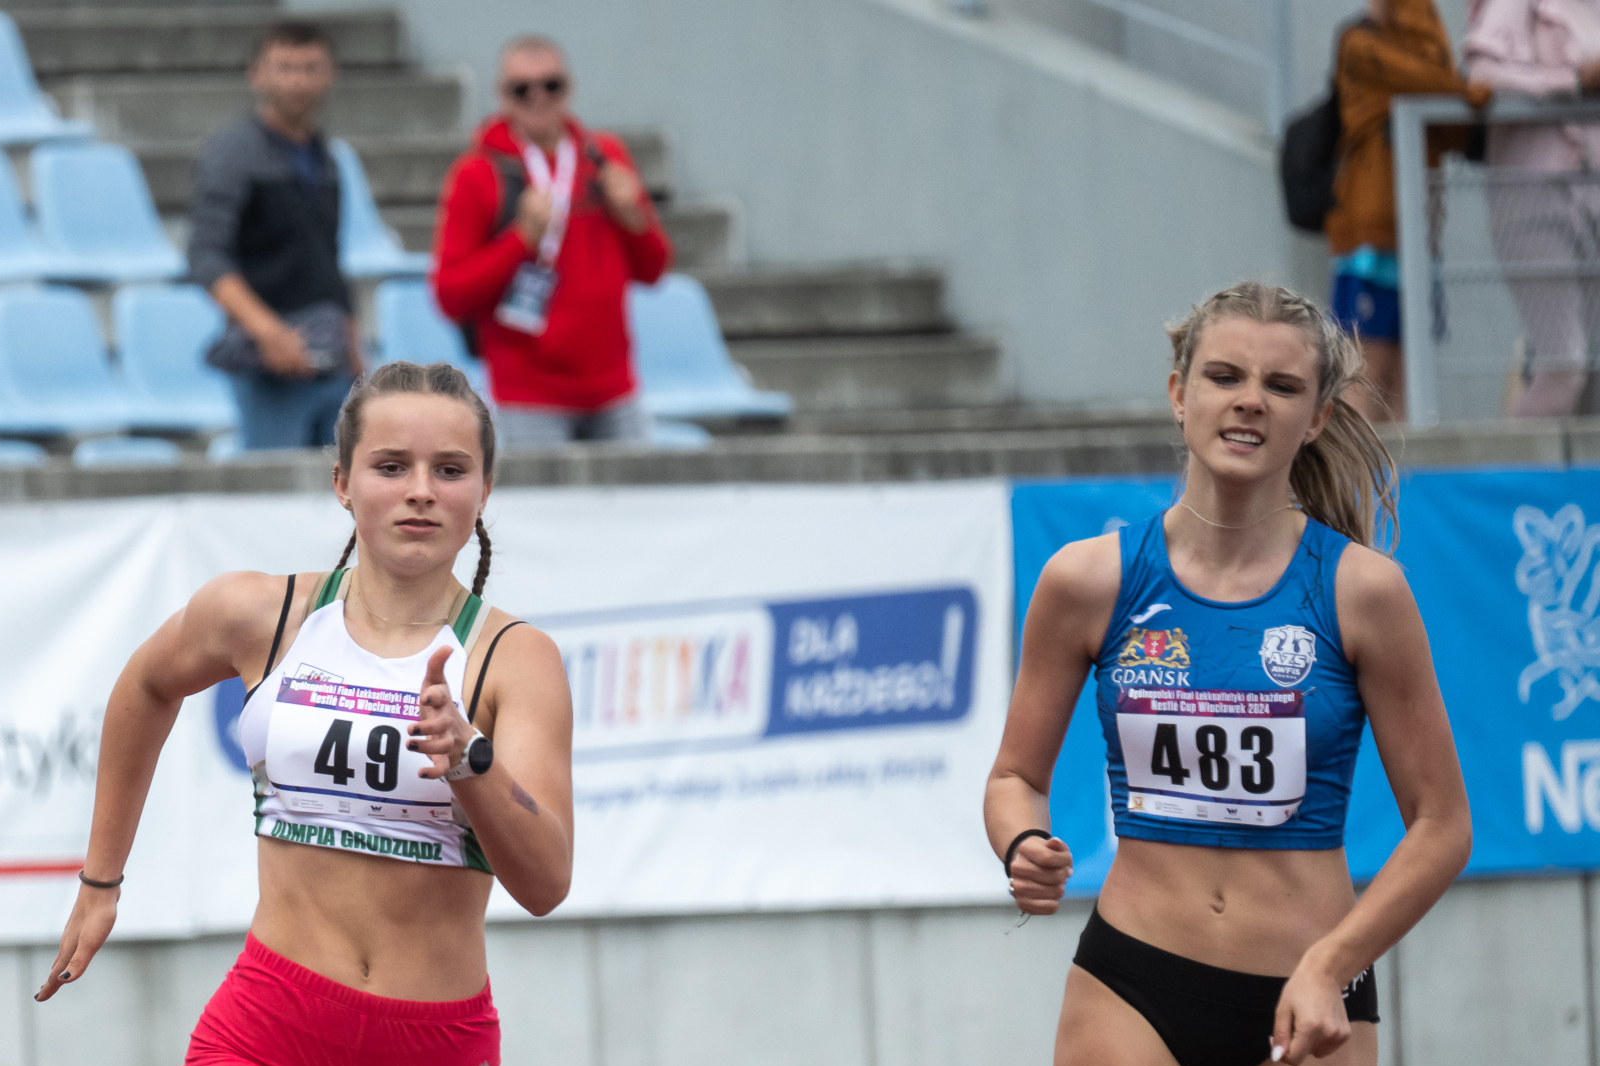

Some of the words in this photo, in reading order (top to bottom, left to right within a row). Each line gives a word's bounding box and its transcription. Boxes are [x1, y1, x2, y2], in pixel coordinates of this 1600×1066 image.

[787, 612, 859, 665] DLA
[1269, 652, 1306, 668] AZS
[1111, 667, 1190, 686] GDAŃSK
[290, 680, 337, 694] Ogólnopolski
[338, 685, 356, 697] Finał
[356, 688, 403, 703] Lekkoatletyki
[403, 694, 416, 704] dla
[1128, 688, 1175, 699] Ogólnopolski
[1176, 690, 1194, 700] Finał
[1195, 691, 1245, 702] Lekkoatletyki
[1246, 692, 1258, 702] dla
[1260, 692, 1295, 703] każdego!
[310, 692, 338, 706] Nestlé
[339, 696, 355, 709] Cup
[357, 698, 401, 714] Włocławek
[403, 705, 420, 717] 202
[1151, 700, 1178, 711] Nestlé
[1179, 701, 1196, 713] Cup
[1198, 702, 1246, 714] Włocławek
[1249, 703, 1270, 714] 2024
[314, 718, 401, 792] 49
[1151, 723, 1275, 794] 483
[270, 820, 336, 847] OLIMPIA
[340, 829, 442, 862] GRUDZIĄDZ
